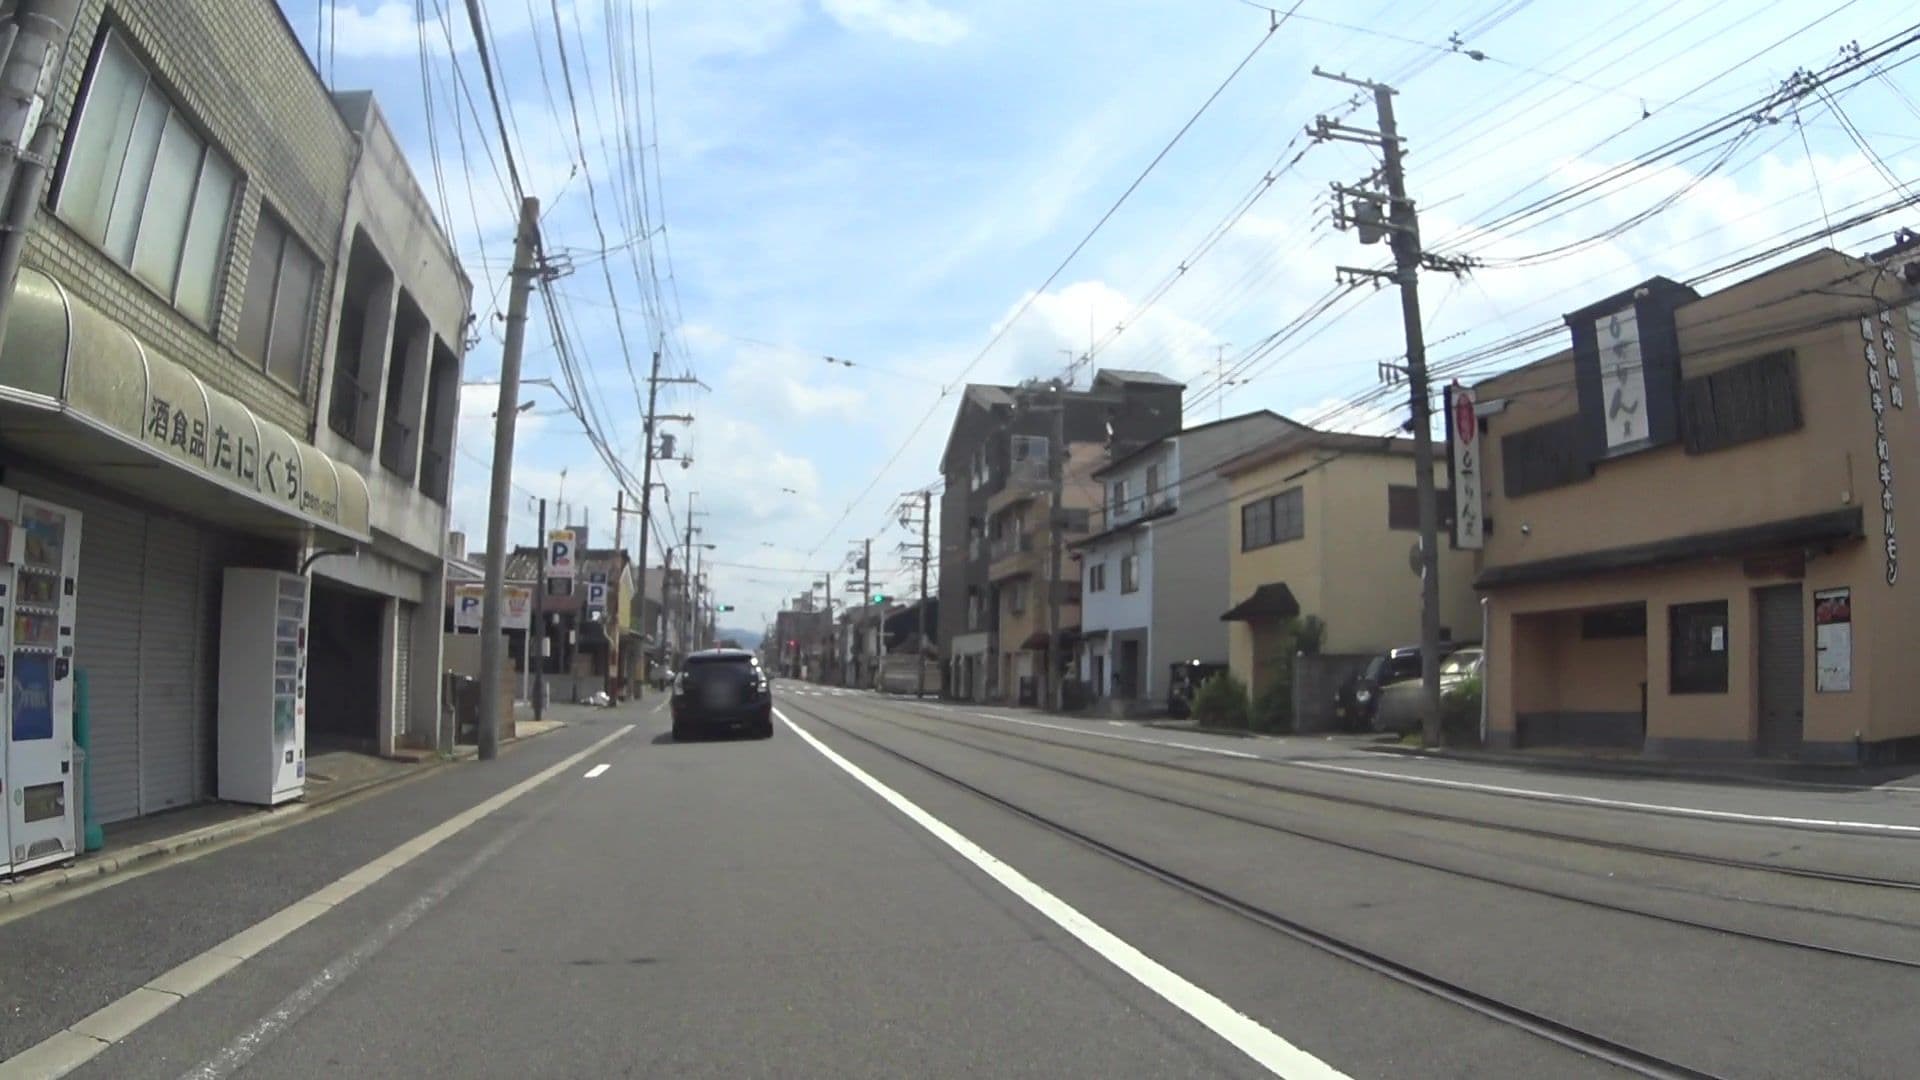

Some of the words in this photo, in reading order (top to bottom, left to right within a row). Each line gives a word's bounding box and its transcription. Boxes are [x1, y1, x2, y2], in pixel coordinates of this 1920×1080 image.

[148, 396, 206, 459] 酒食品
[213, 425, 300, 500] たにぐち
[552, 541, 569, 566] P
[590, 586, 603, 602] P
